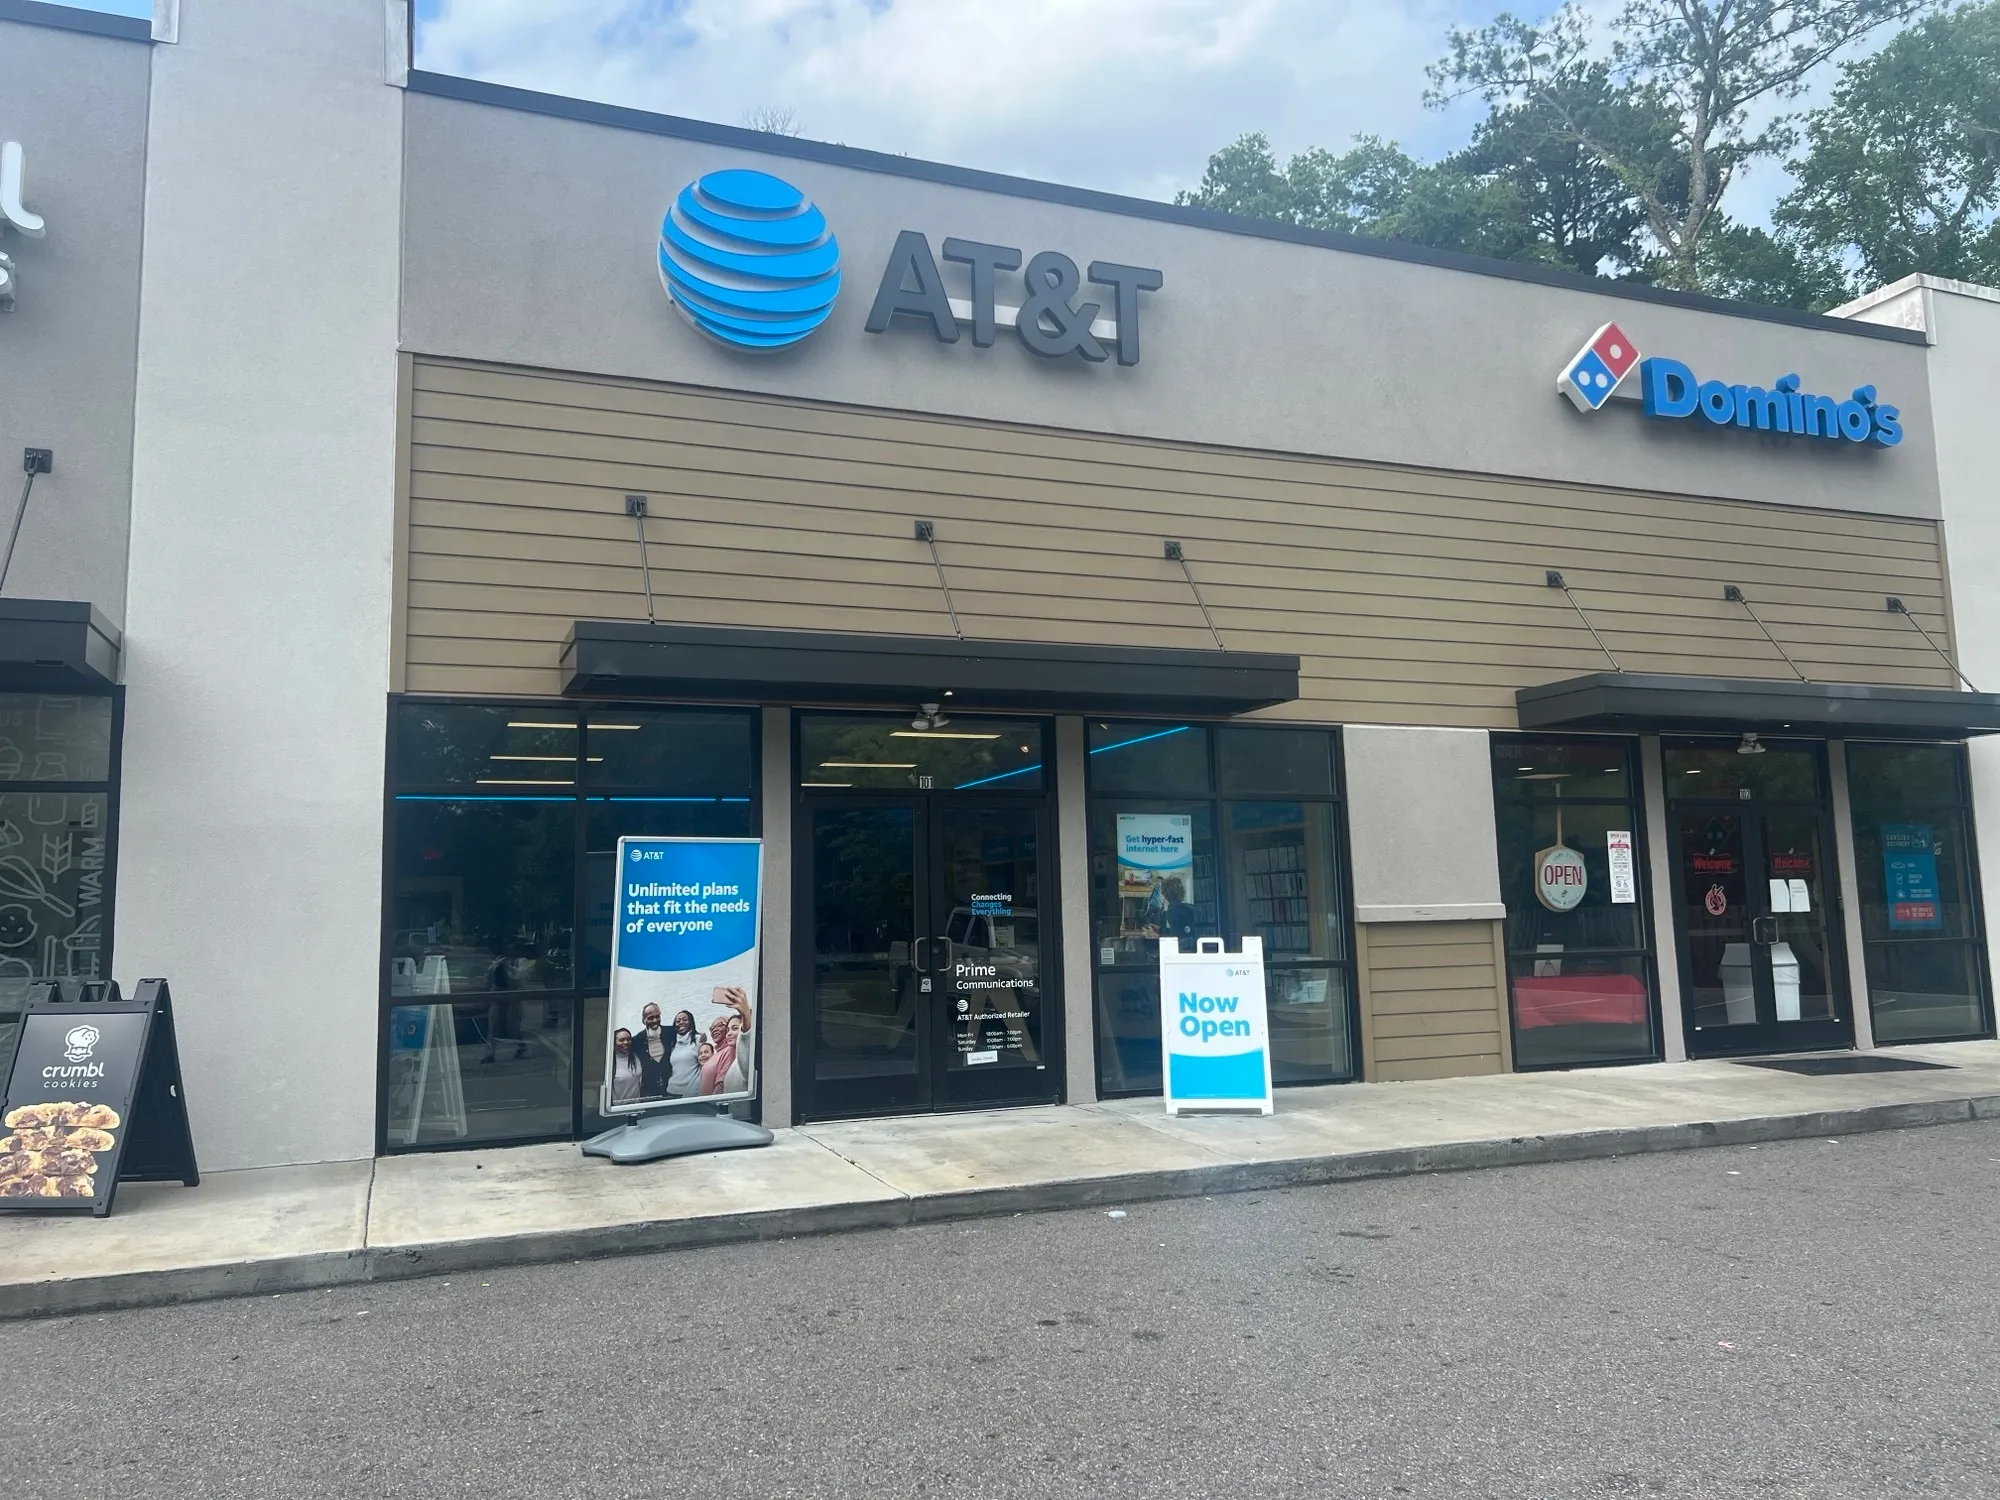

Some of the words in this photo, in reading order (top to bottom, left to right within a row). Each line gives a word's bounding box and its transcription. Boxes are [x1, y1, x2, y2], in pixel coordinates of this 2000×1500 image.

[864, 229, 1163, 367] AT&T
[1640, 356, 1904, 447] Domino's
[919, 775, 934, 790] 101
[1740, 788, 1751, 800] 102
[1126, 835, 1140, 843] Get
[1141, 834, 1184, 845] hyper-fast
[1126, 844, 1159, 852] internet
[1160, 844, 1178, 852] here
[643, 851, 664, 860] AT&T
[1694, 857, 1732, 869] Welcome
[78, 837, 104, 908] WARM
[1544, 865, 1583, 886] OPEN
[628, 883, 700, 897] Unlimited
[702, 882, 739, 899] plans
[971, 893, 1012, 902] Connecting
[627, 901, 661, 915] that
[663, 900, 682, 914] fit
[684, 900, 708, 914] the
[710, 899, 750, 913] needs
[972, 901, 1002, 909] Changes
[626, 918, 645, 933] of
[646, 920, 713, 935] everyone
[956, 964, 996, 977] Prime
[956, 979, 1034, 990] Communications
[1179, 992, 1238, 1013] Now
[974, 1012, 1006, 1020] Authorized
[1179, 1015, 1251, 1043] Open
[42, 1062, 105, 1078] crumbl
[43, 1079, 98, 1088] cookies
